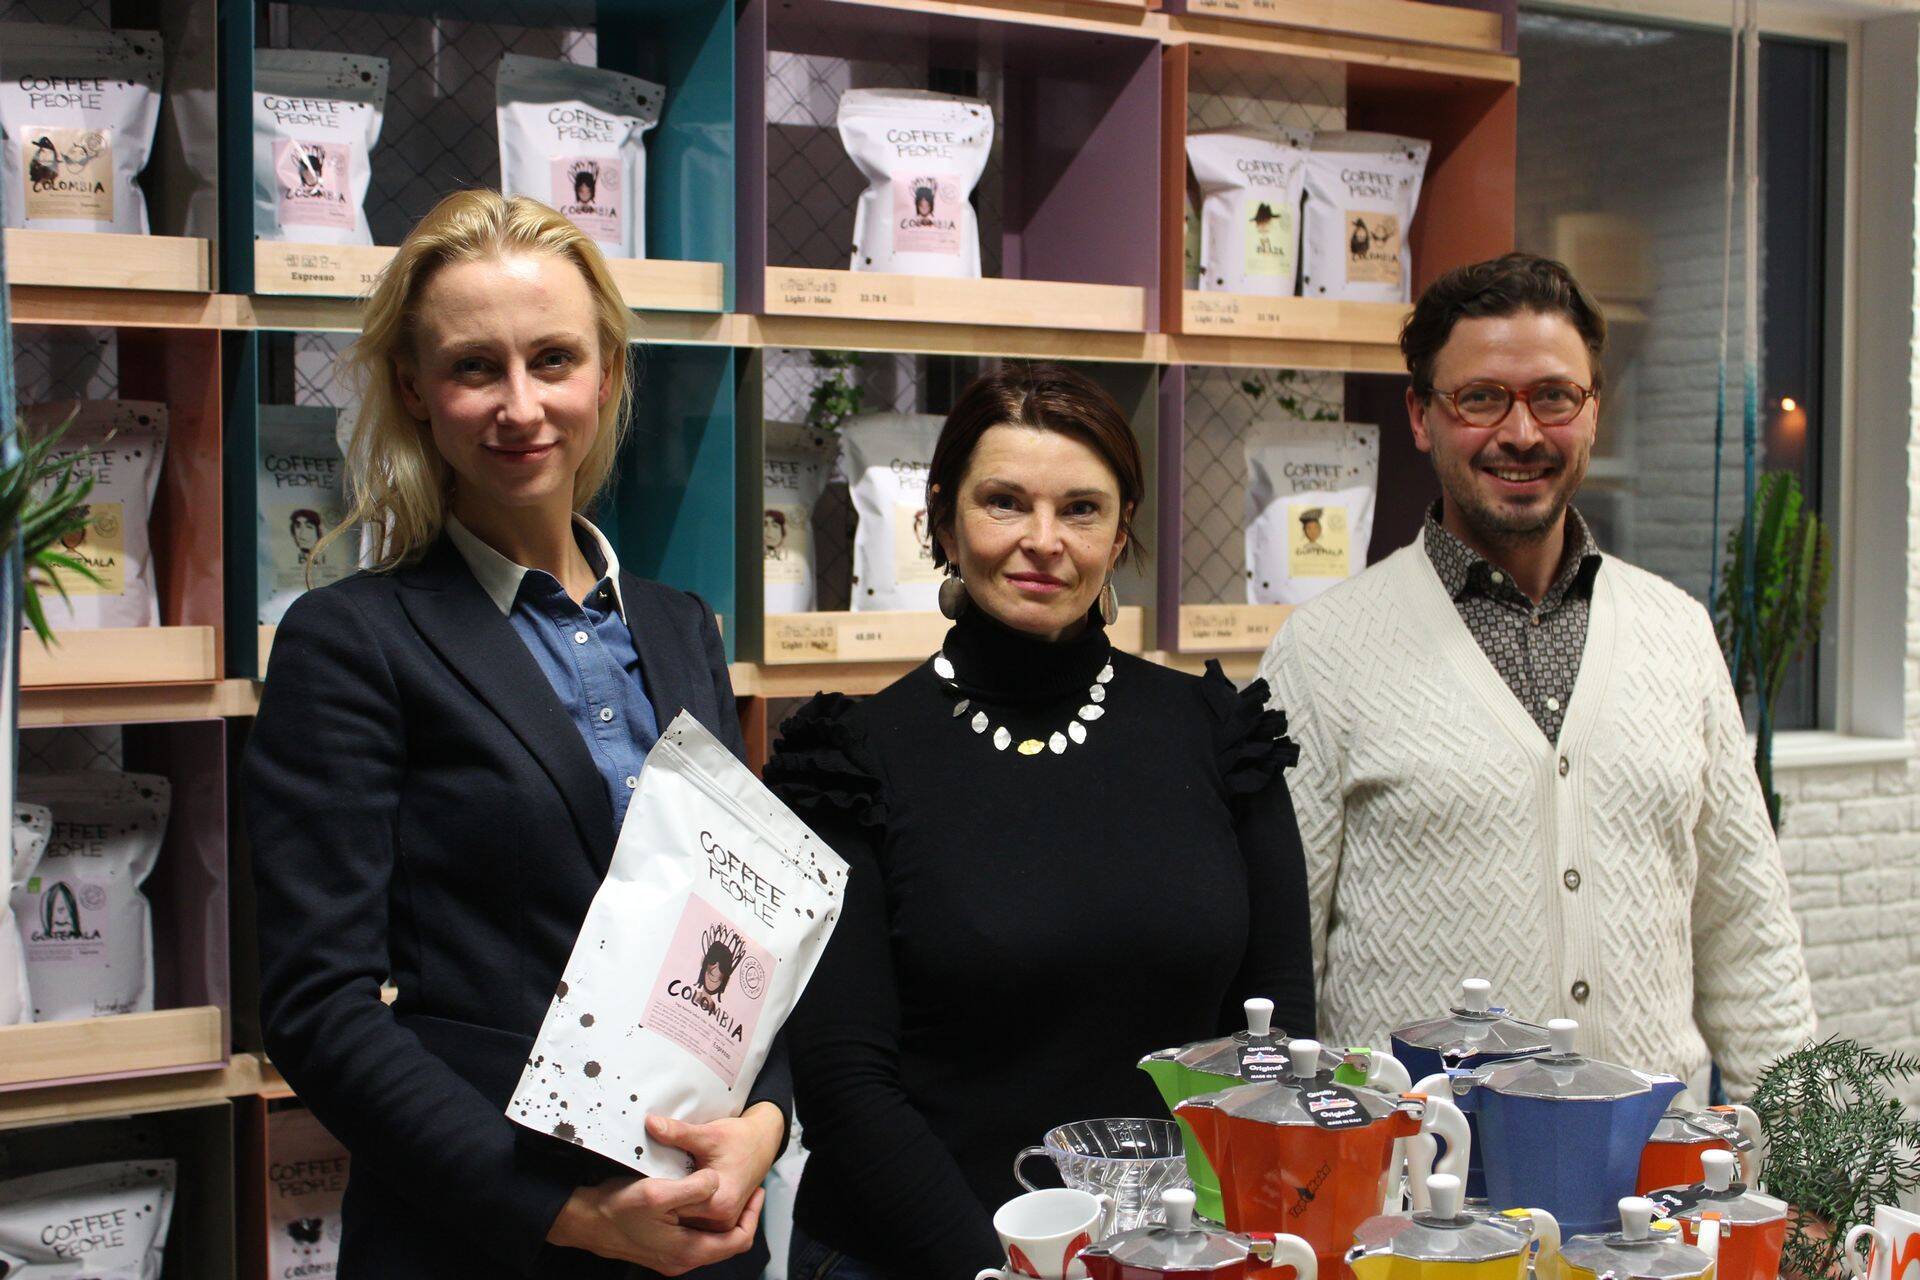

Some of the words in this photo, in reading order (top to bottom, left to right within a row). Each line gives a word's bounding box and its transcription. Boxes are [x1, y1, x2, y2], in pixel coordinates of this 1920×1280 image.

[20, 75, 108, 91] COFFEE
[30, 93, 102, 110] PEOPLE
[263, 96, 340, 113] COFFEE
[274, 111, 339, 128] PEOPLE
[548, 108, 615, 132] COFFEE
[557, 125, 615, 143] PEOPLE
[887, 128, 955, 143] COFFEE
[896, 144, 953, 159] PEOPLE
[1236, 158, 1285, 174] COFFEE
[1340, 168, 1394, 186] COFFEE
[33, 179, 105, 194] COLOMBIA
[285, 187, 347, 204] COLMBIA
[291, 271, 335, 282] Espresso
[265, 454, 338, 472] COFFEE
[1283, 462, 1344, 479] COFFEE
[274, 472, 333, 490] PEOPLE
[1290, 478, 1338, 493] PEOPLE
[52, 821, 113, 839] FFEE
[47, 841, 103, 858] EOPLE
[700, 830, 786, 907] COFFEE
[708, 857, 776, 929] PEOPLE
[667, 979, 743, 1043] COLOMBIA
[1249, 1064, 1283, 1073] Original
[1306, 1089, 1338, 1099] Quality
[1320, 1108, 1356, 1118] Original
[269, 1157, 347, 1182] COFFEE
[279, 1175, 343, 1197] PEOPLE
[41, 1208, 127, 1246] COFFEE
[53, 1228, 124, 1259] PEOPLE
